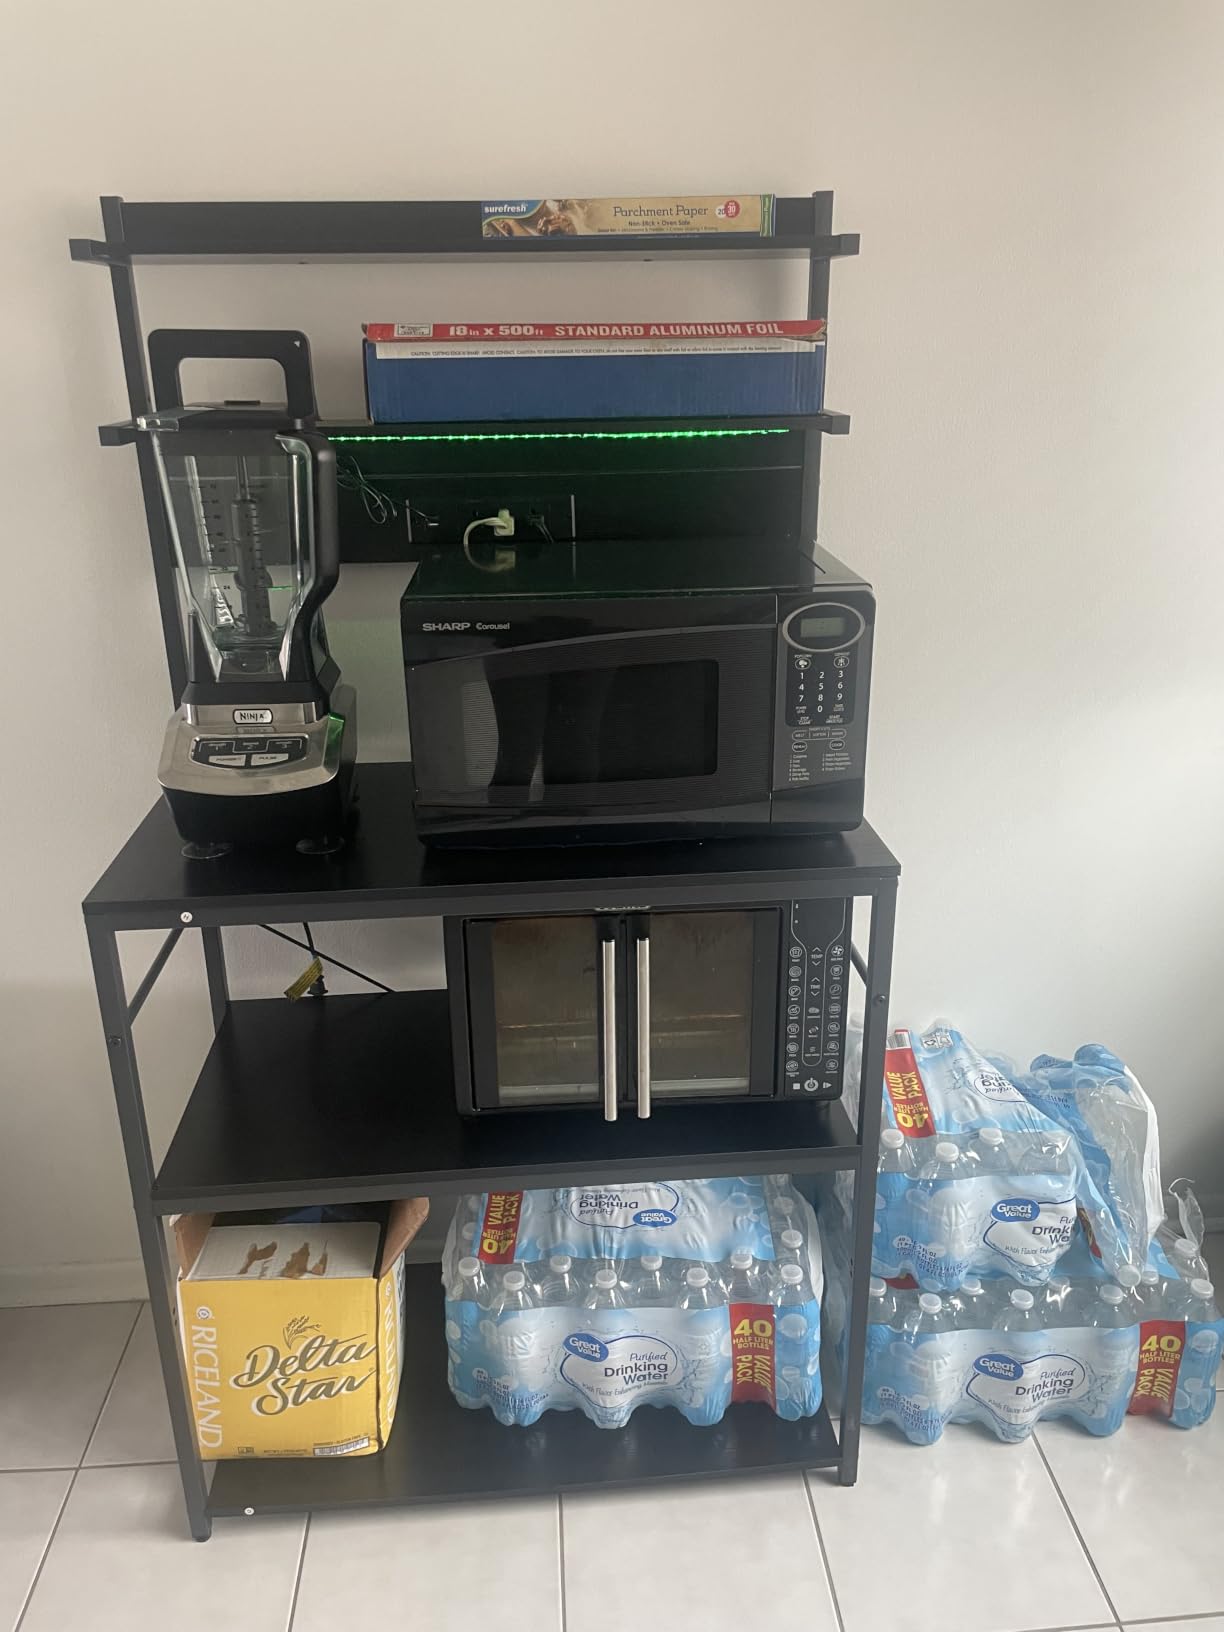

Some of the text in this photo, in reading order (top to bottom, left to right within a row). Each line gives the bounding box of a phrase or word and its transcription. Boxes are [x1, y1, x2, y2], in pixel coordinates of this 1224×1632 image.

[484, 204, 526, 213] surefresh
[613, 204, 708, 218] Parchment Paper
[727, 205, 736, 213] 30
[555, 325, 644, 336] STANDARD
[650, 324, 742, 336] ALUMINUM
[746, 323, 784, 335] FOIL
[422, 622, 510, 631] SHARP Carousel
[800, 672, 804, 680] 1
[819, 671, 825, 679] 2
[838, 670, 844, 678] 3
[799, 683, 804, 691] 4
[818, 682, 824, 690] 5
[837, 681, 843, 689] 6
[837, 693, 843, 701] 9
[817, 705, 823, 713] 0
[240, 711, 265, 721] NINJA
[887, 1071, 907, 1100] VALUE
[896, 1112, 928, 1128] 40
[579, 1193, 621, 1202] Water
[487, 1195, 506, 1225] VALUE
[579, 1200, 639, 1209] Drinking
[996, 1203, 1032, 1213] Great
[640, 1214, 672, 1224] Great
[1004, 1210, 1032, 1218] Value
[483, 1239, 514, 1255] 40
[734, 1318, 773, 1337] 40
[569, 1337, 601, 1353] Great
[733, 1337, 753, 1345] HALF
[1141, 1335, 1182, 1352] 40
[577, 1346, 601, 1359] Value
[629, 1352, 668, 1362] Purified
[1140, 1351, 1181, 1360] HALF LITER
[231, 1333, 378, 1389] Delta
[979, 1358, 1015, 1372] Great
[1143, 1356, 1175, 1364] BOTTLES
[604, 1362, 668, 1377] Drinking
[736, 1354, 753, 1385] PACK
[753, 1354, 772, 1393] VALUE
[987, 1365, 1014, 1377] Value
[1040, 1367, 1076, 1380] Purified
[623, 1373, 668, 1385] Water
[1135, 1368, 1156, 1397] PACK
[191, 1325, 222, 1448] RICELAND
[1015, 1378, 1074, 1396] Drinking
[1150, 1368, 1174, 1403] VALUE
[254, 1370, 377, 1416] Star
[1031, 1387, 1073, 1403] Water
